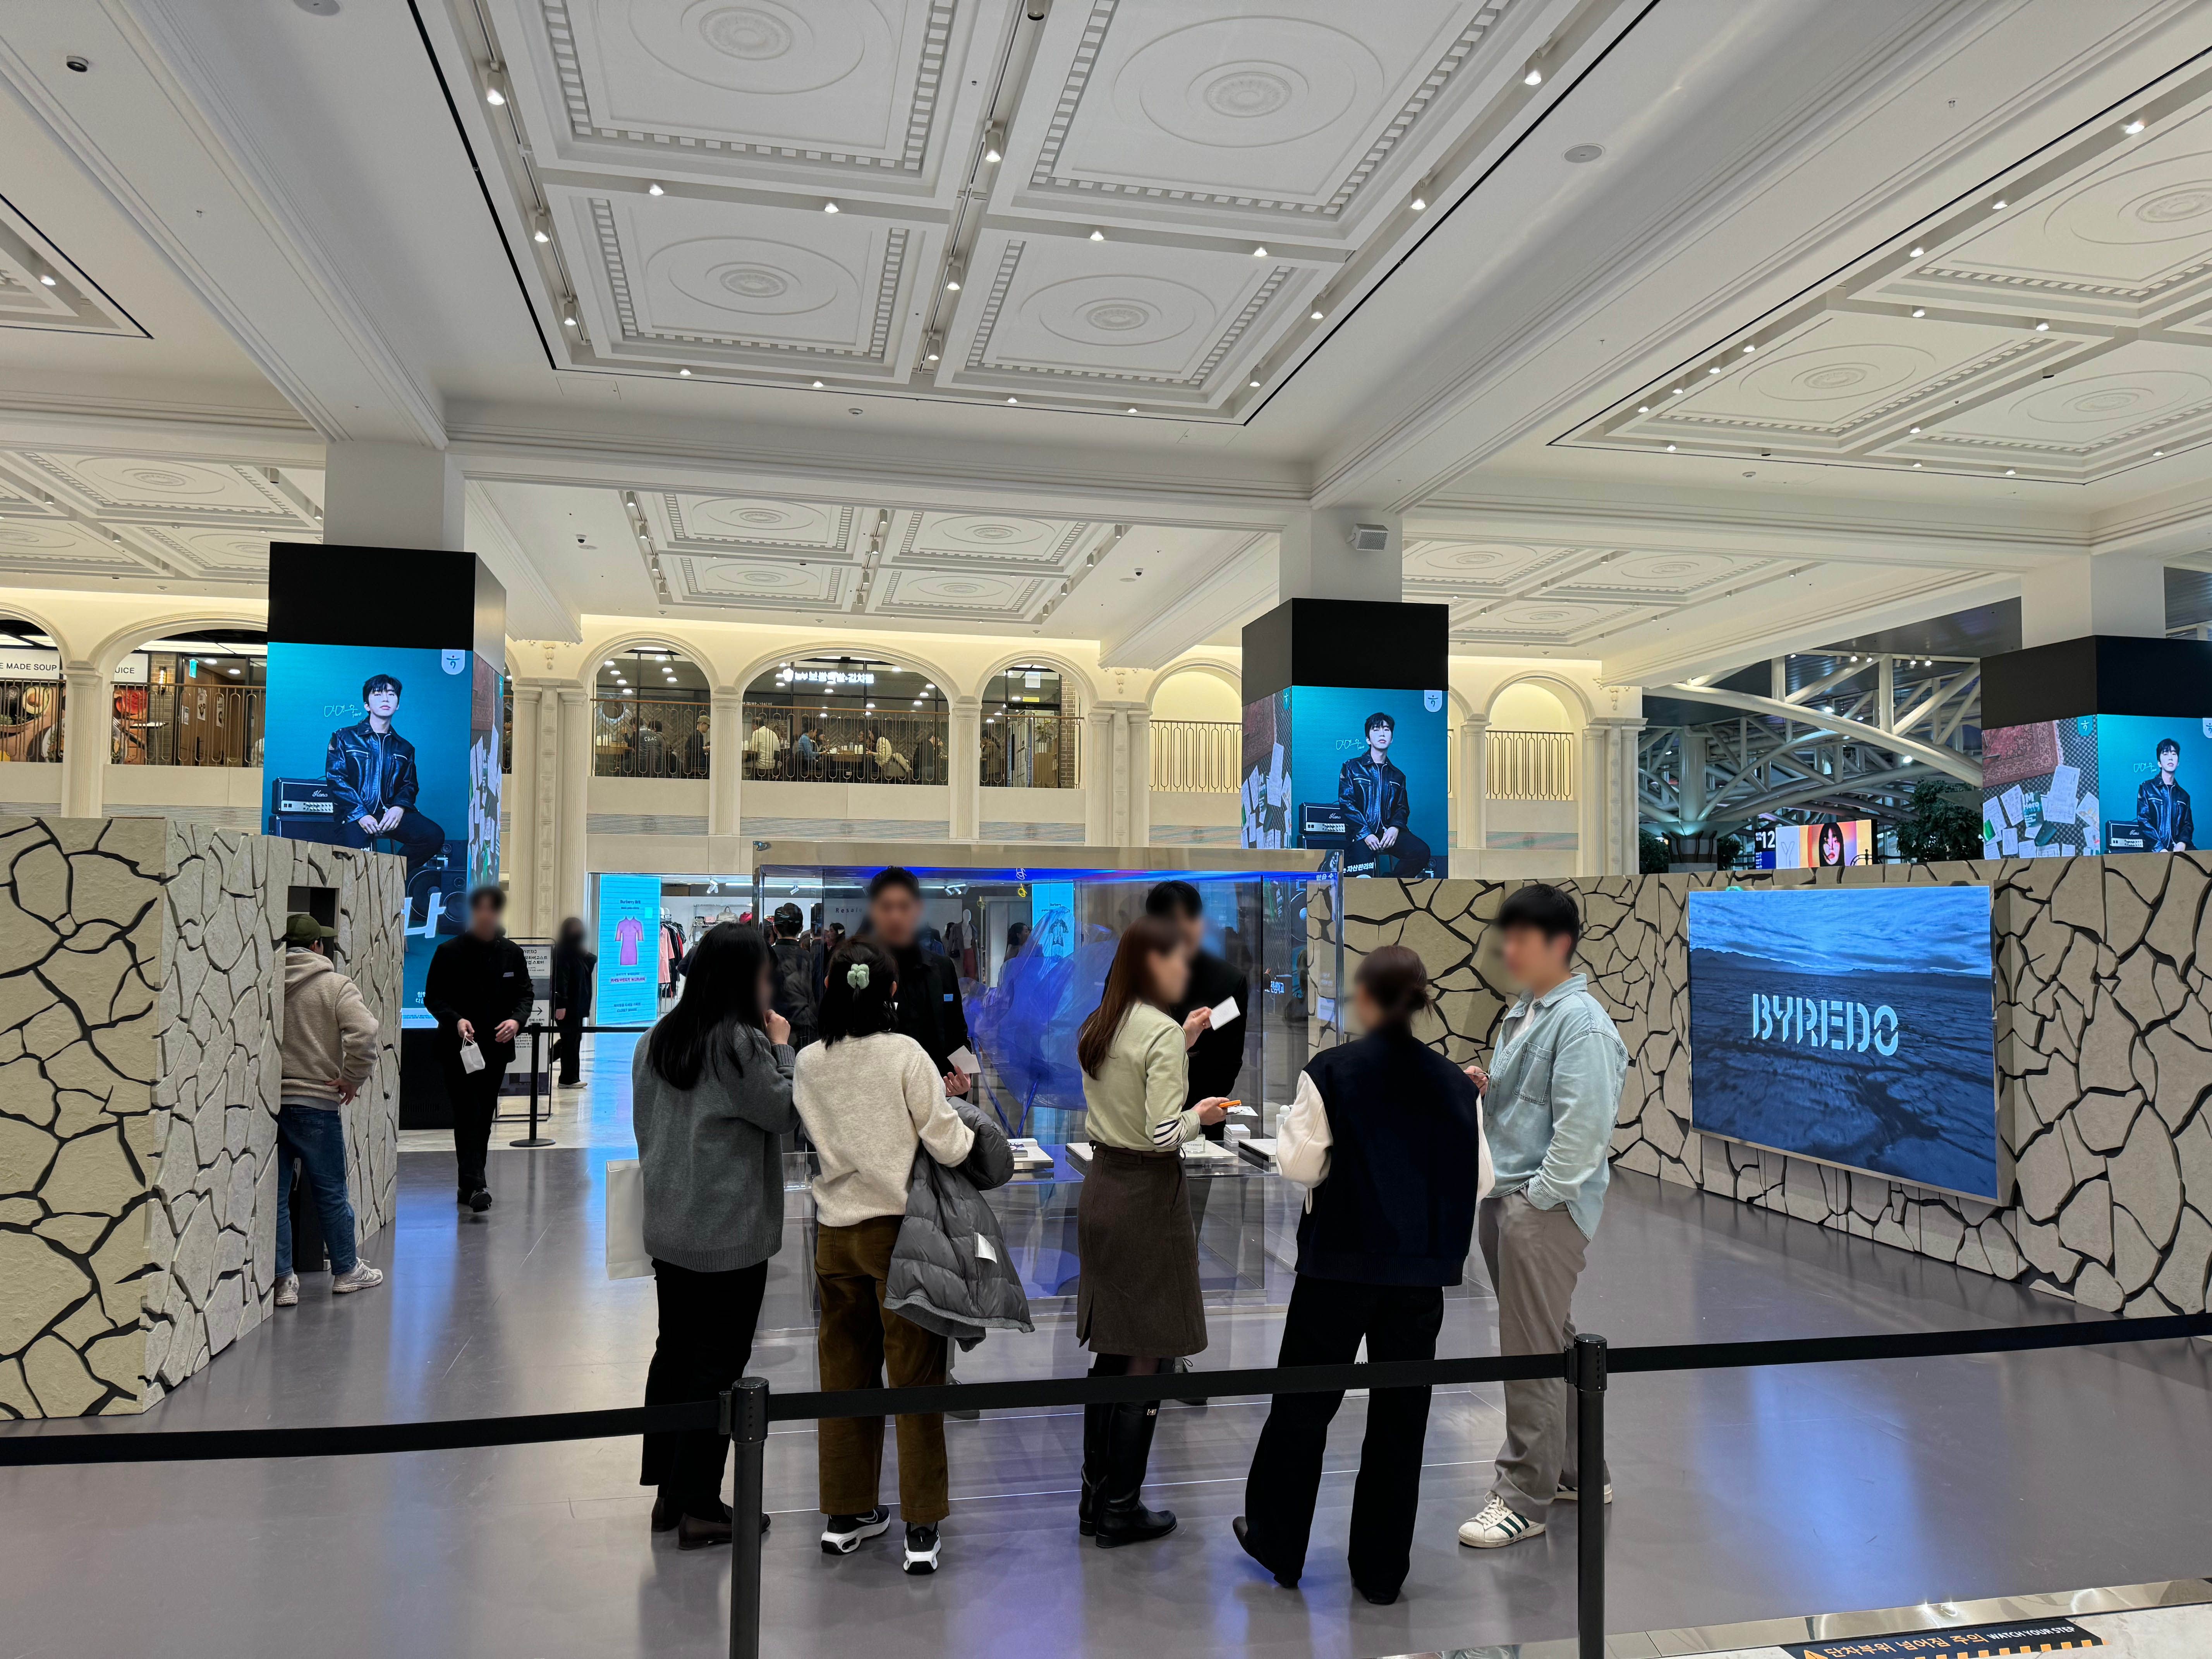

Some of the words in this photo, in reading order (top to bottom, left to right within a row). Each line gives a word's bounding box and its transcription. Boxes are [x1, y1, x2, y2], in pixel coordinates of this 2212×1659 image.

[1761, 831, 1776, 848] 12
[1753, 993, 1898, 1056] BYREDO
[1824, 1642, 1897, 1657] 단차부위
[1895, 1637, 1951, 1650] 넘어짐
[1949, 1633, 1989, 1645] 주의
[1986, 1632, 2024, 1640] WATCH
